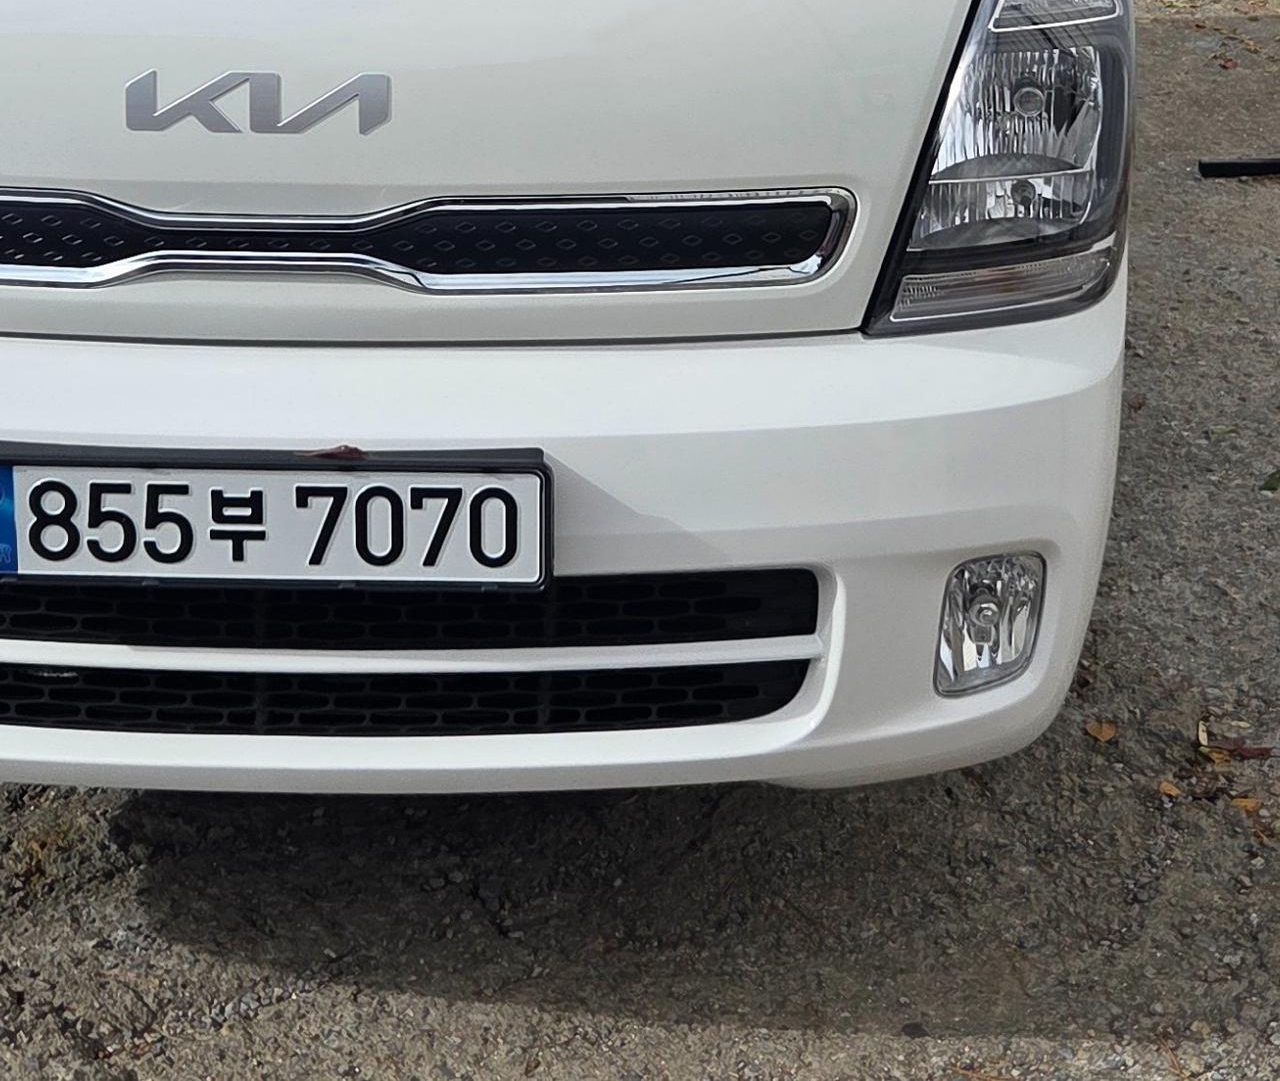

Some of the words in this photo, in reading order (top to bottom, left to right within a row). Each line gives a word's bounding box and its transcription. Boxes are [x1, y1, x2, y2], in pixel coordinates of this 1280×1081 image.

[125, 68, 392, 135] KIA
[28, 480, 266, 564] 855부
[295, 485, 518, 568] 7070
